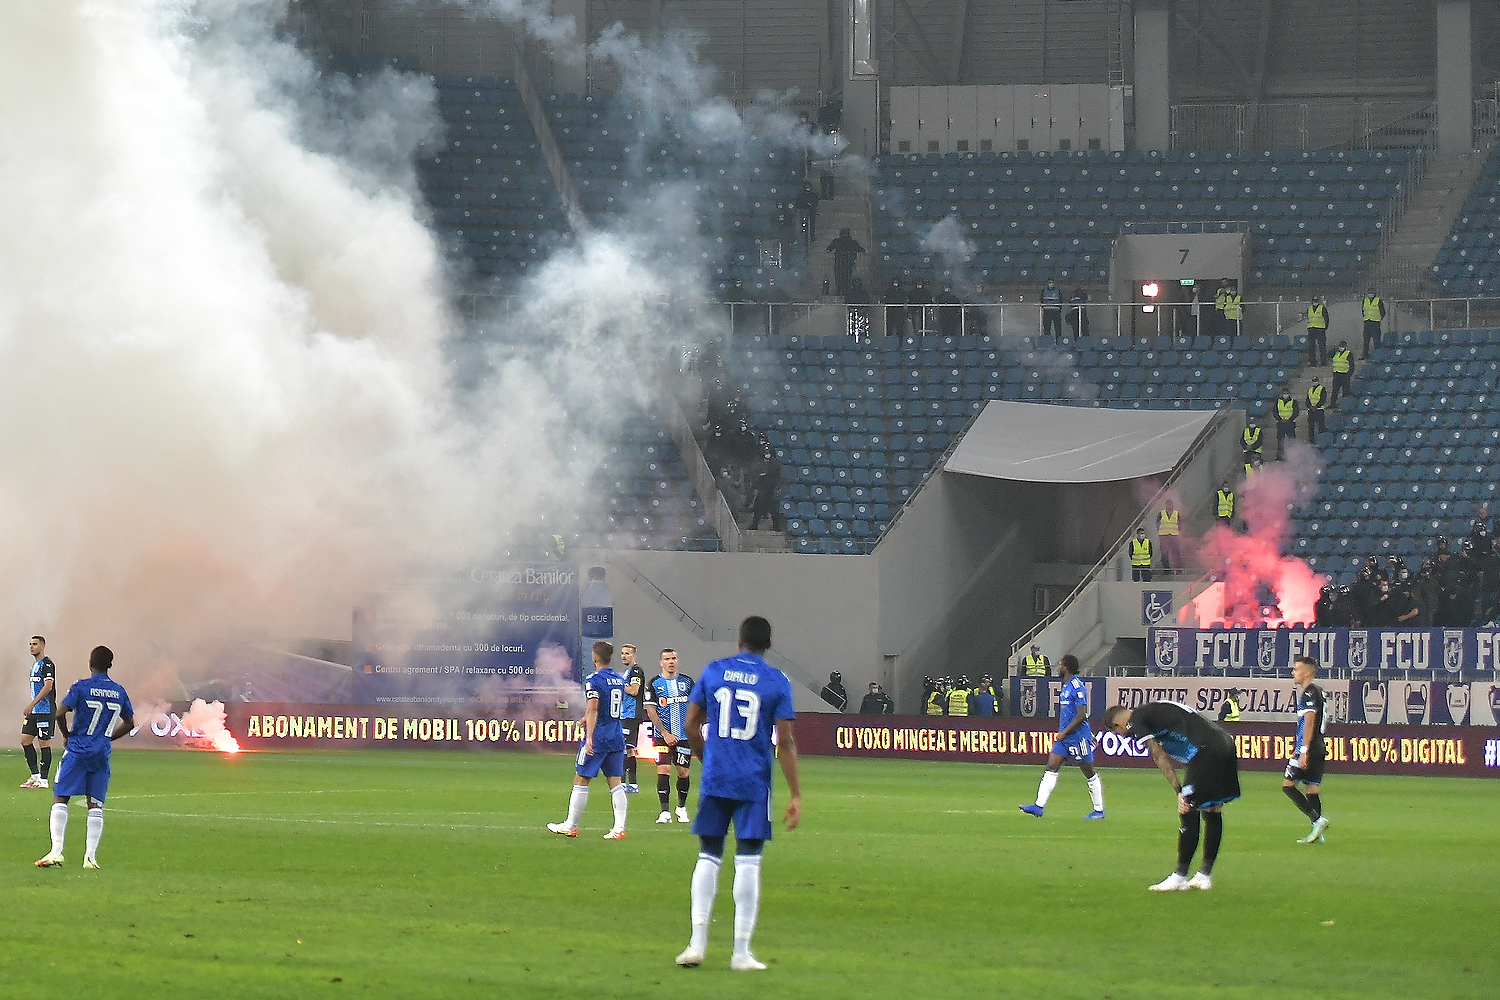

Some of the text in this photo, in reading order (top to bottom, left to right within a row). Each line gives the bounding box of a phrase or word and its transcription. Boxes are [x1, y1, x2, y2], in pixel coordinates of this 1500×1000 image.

[1178, 249, 1190, 265] 7
[526, 568, 574, 585] Banilor
[520, 613, 529, 622] tip
[587, 614, 608, 623] BLUE
[474, 643, 489, 652] 300
[490, 644, 500, 652] de
[501, 644, 525, 652] locuri.
[1195, 632, 1246, 669] FCU
[1288, 633, 1336, 669] FCU
[1380, 632, 1430, 669] FCU
[444, 666, 460, 674] SPA
[466, 666, 496, 674] relaxare
[508, 666, 523, 674] 500
[723, 669, 758, 686] DIALLO
[610, 688, 622, 718] 8
[713, 686, 759, 741] 13
[85, 699, 122, 738] 77
[248, 715, 369, 738] ABONAMENT
[374, 717, 398, 740] DE
[403, 718, 461, 741] MOBIL
[465, 719, 520, 742] 100%
[836, 727, 853, 749] CU
[855, 727, 890, 750] YOXO
[893, 728, 945, 751] MINGEA
[948, 730, 957, 751] E
[959, 730, 1007, 753] MEREU
[1010, 731, 1028, 753] LA
[1350, 737, 1398, 763] 100%
[1401, 739, 1465, 764] DIGITAL
